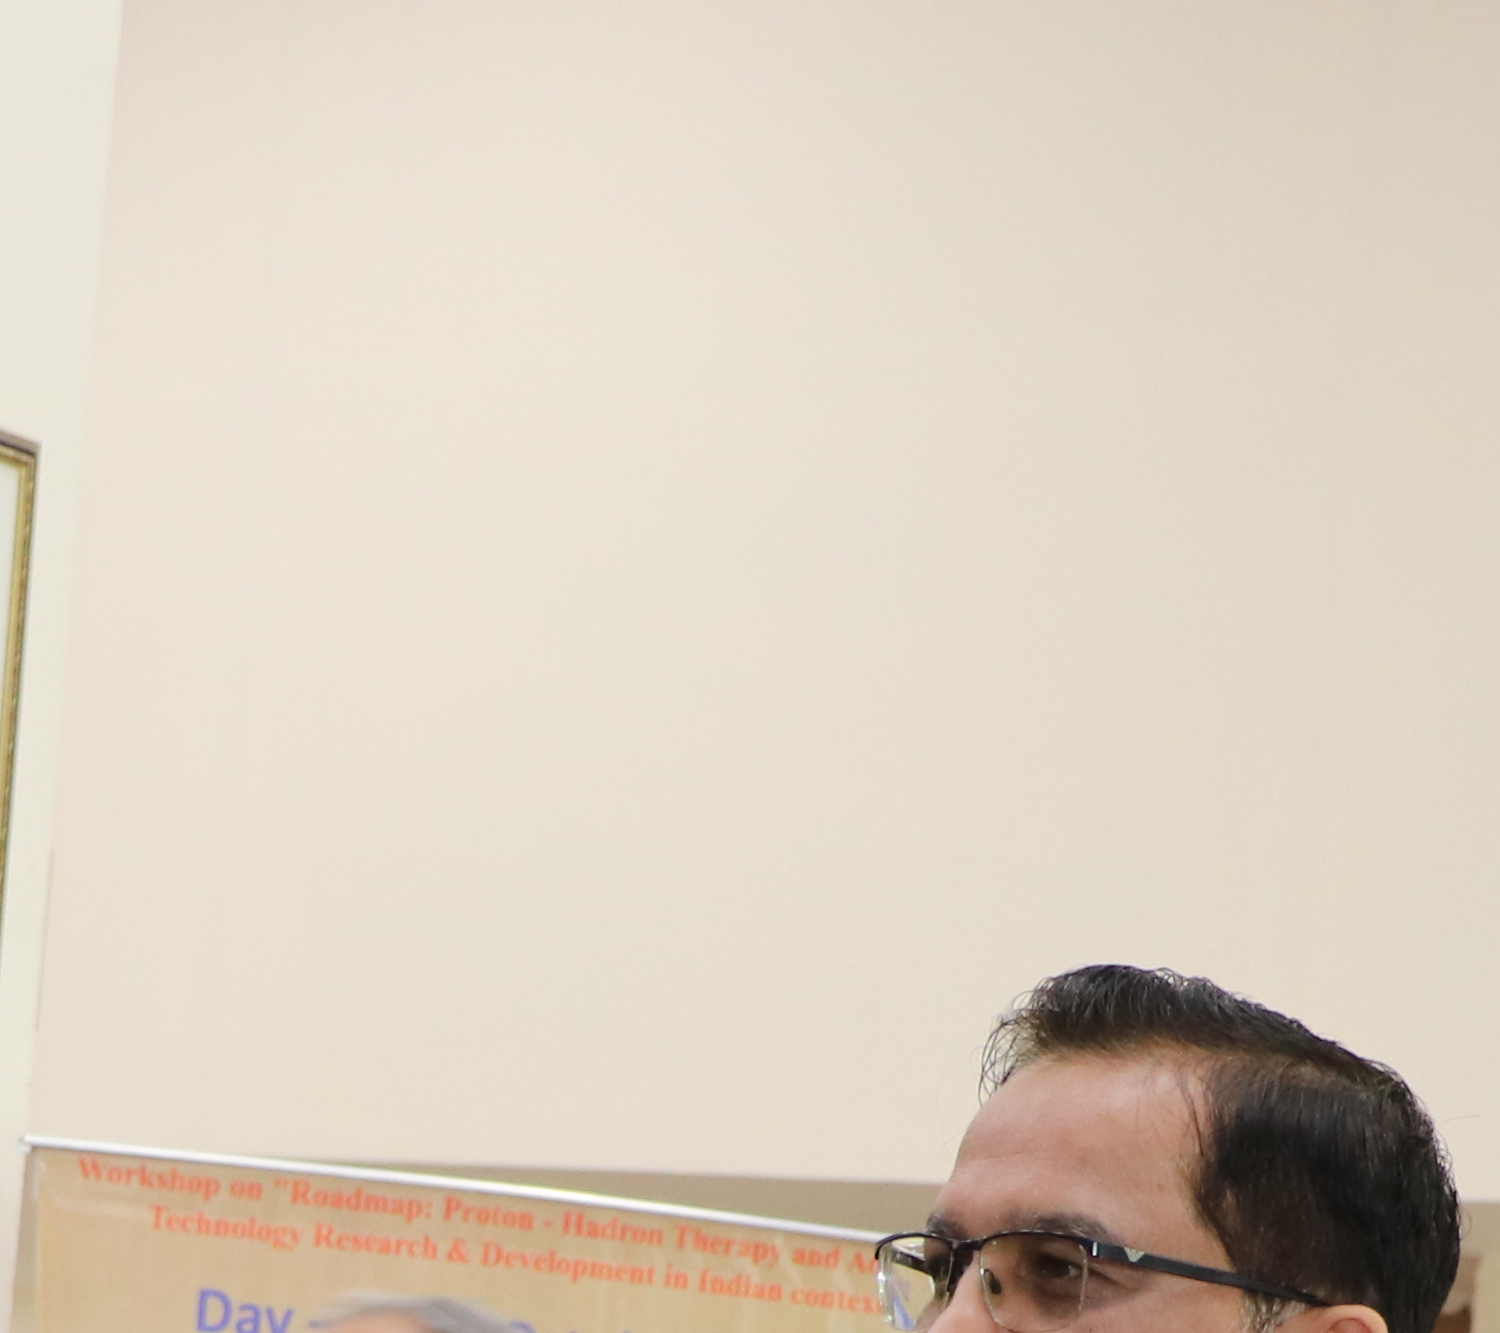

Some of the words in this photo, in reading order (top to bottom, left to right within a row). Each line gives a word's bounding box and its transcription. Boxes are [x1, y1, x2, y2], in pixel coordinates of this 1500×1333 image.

[79, 1157, 221, 1200] Workshop
[230, 1175, 263, 1200] on
[274, 1176, 434, 1224] "Roadmap:
[443, 1197, 536, 1231] Proton
[563, 1210, 665, 1248] Hadron
[676, 1225, 782, 1271] Therapy
[792, 1242, 843, 1271] and
[151, 1203, 304, 1251] Technology
[314, 1223, 438, 1261] Research
[447, 1239, 471, 1264] &
[482, 1241, 656, 1284] Development
[664, 1263, 690, 1290] in
[699, 1269, 784, 1303] Indian
